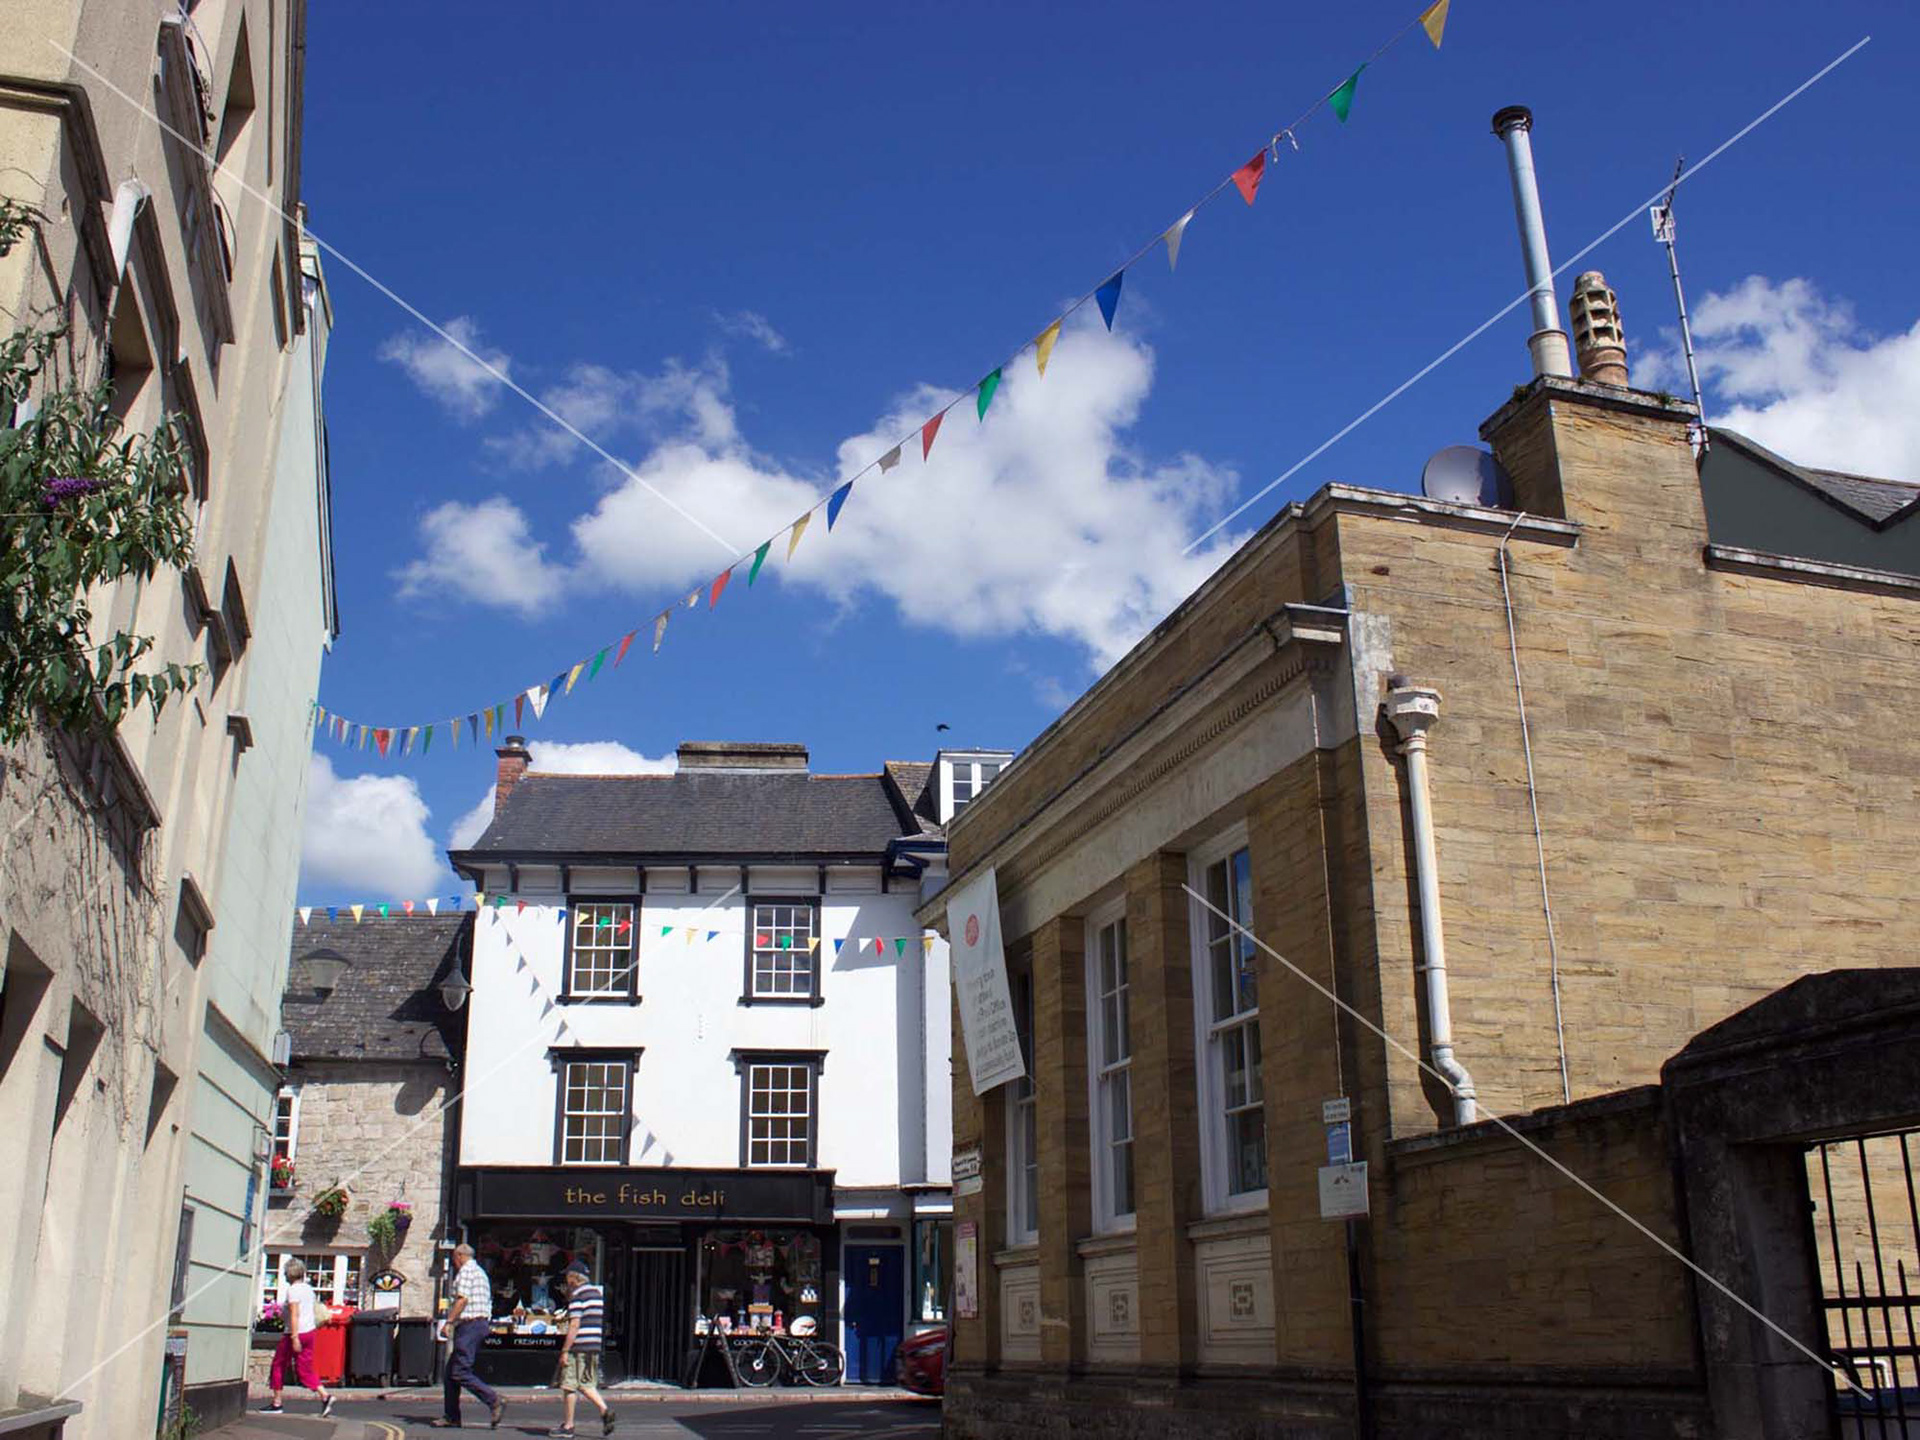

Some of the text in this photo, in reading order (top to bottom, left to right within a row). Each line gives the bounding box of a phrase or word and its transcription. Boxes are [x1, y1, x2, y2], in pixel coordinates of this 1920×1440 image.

[565, 1183, 725, 1206] the fish deli
